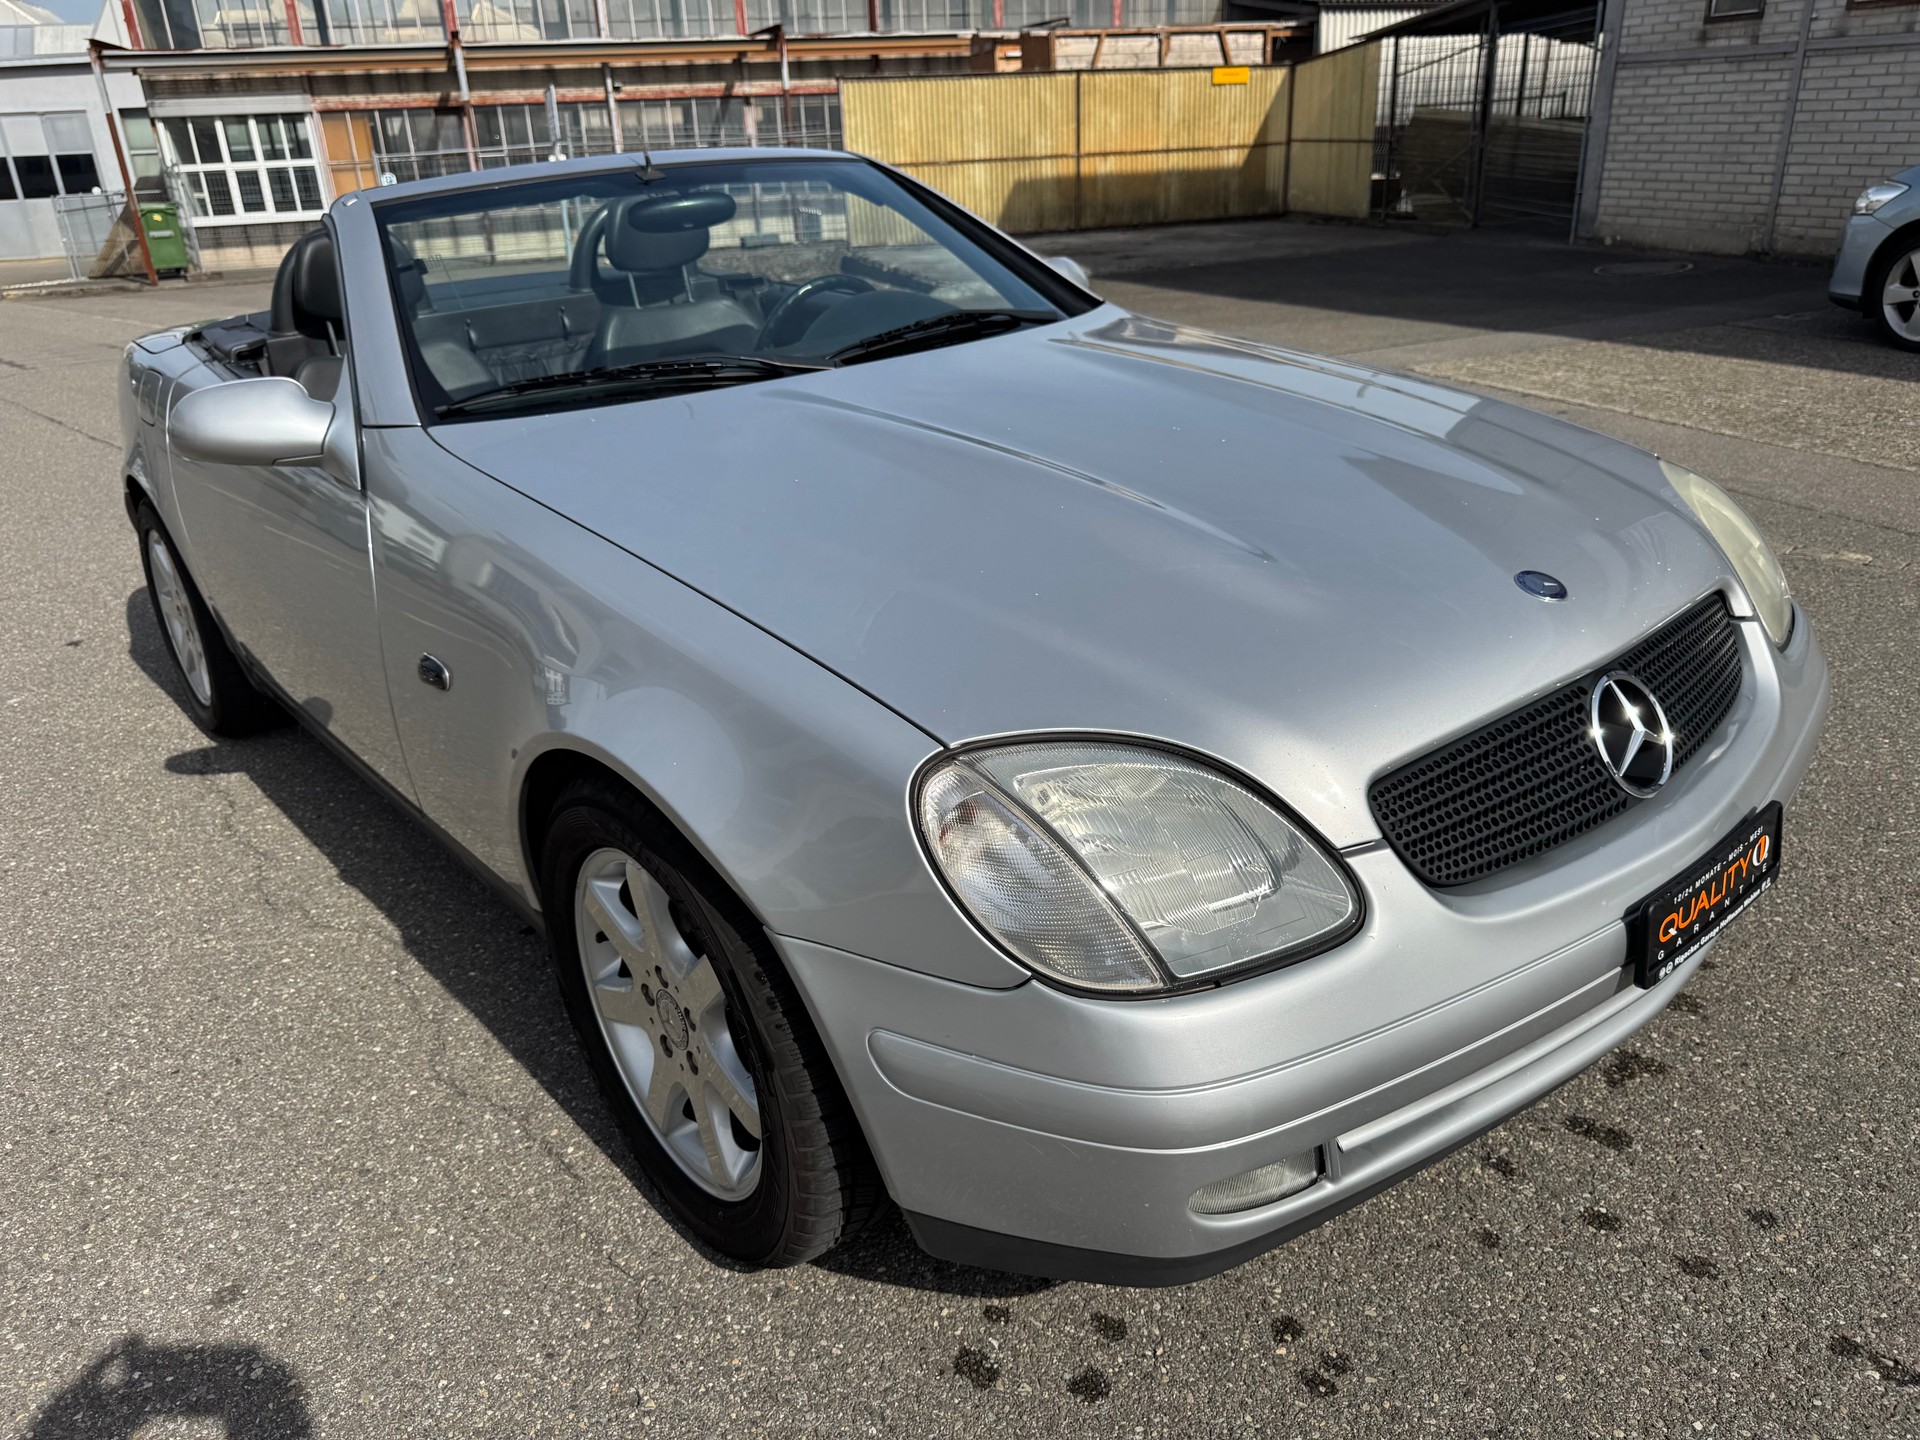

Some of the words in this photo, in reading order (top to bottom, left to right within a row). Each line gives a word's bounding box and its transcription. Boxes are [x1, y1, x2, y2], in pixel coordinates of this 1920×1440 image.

[1659, 848, 1753, 943] QUALITY
[1673, 885, 1693, 905] 12/24
[1694, 862, 1722, 889] MONATE
[1728, 843, 1744, 861] MOIS
[1749, 825, 1763, 842] MESI
[1657, 862, 1768, 961] GARANTIE
[1700, 926, 1720, 946] Garage
